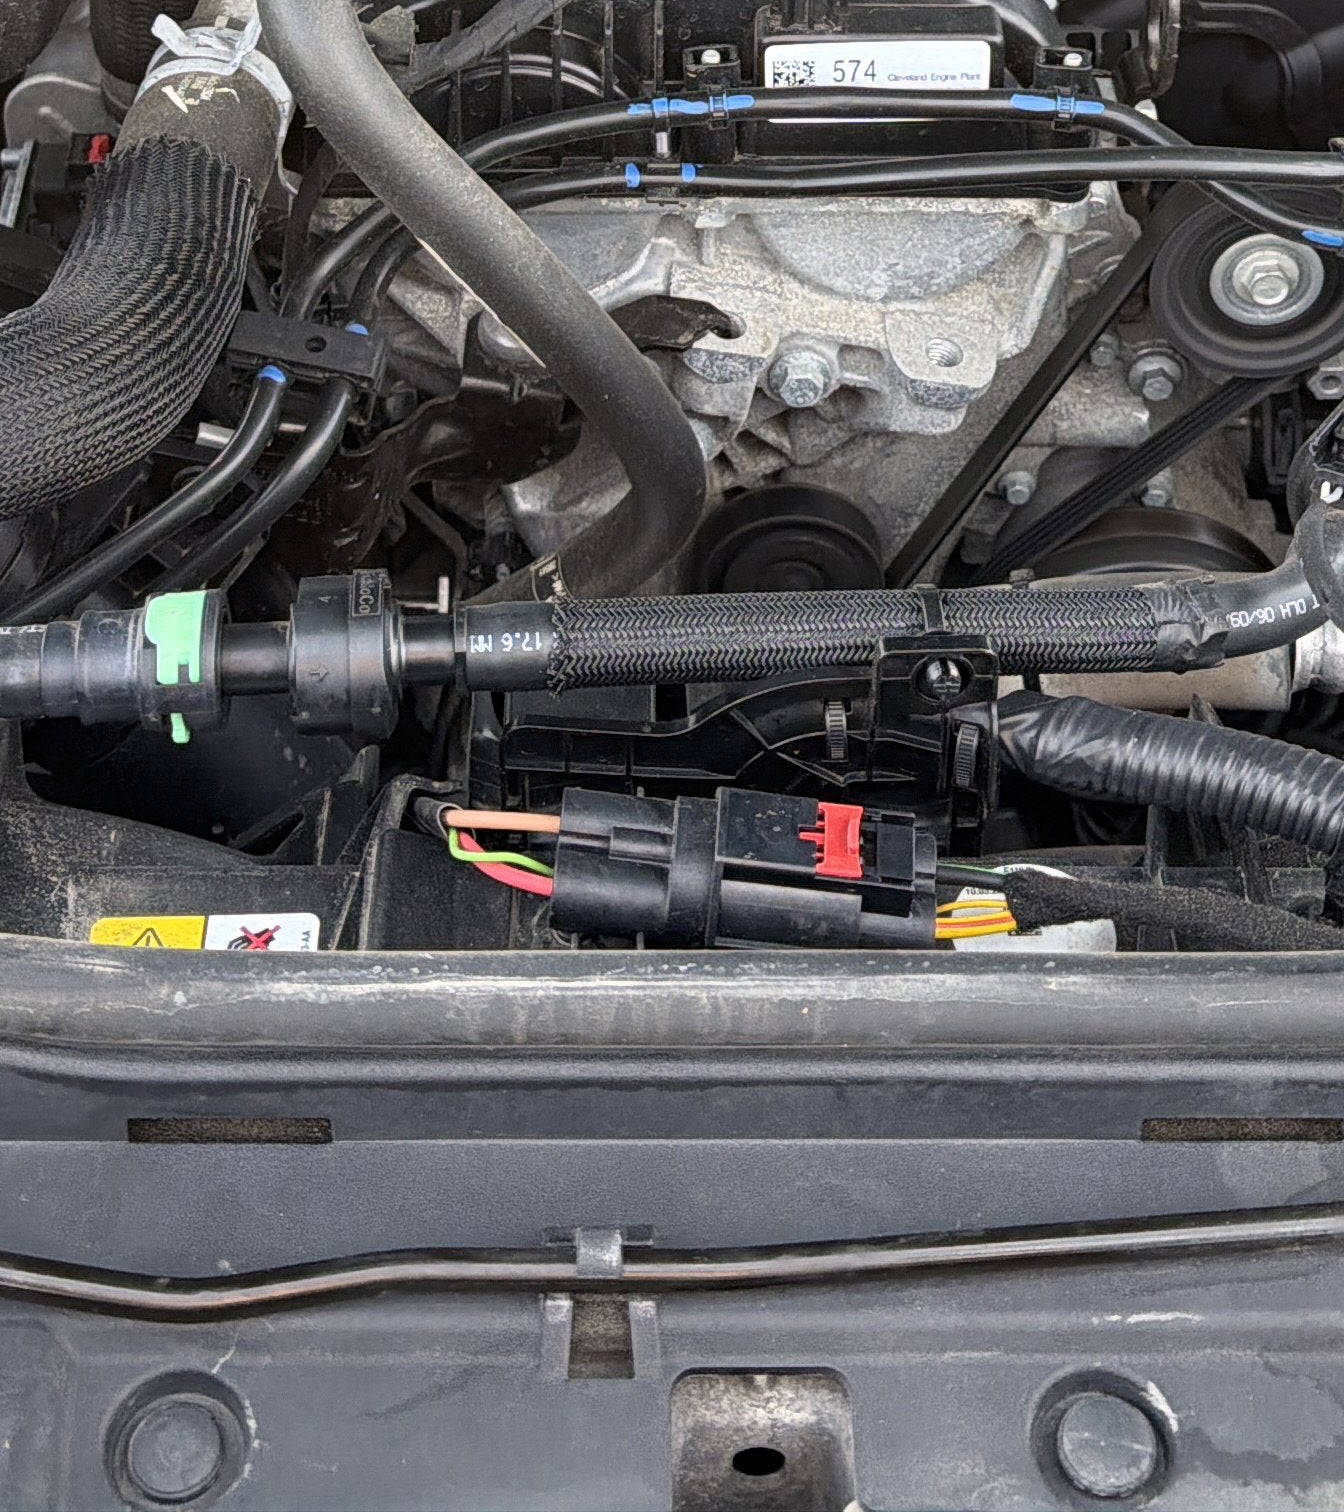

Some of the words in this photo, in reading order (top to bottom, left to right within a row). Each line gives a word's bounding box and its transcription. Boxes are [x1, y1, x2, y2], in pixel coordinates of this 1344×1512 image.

[832, 59, 877, 83] 574
[887, 73, 927, 82] Cleveland
[930, 73, 957, 82] Engine
[960, 72, 980, 81] Plant
[469, 634, 493, 653] MM
[501, 631, 542, 652] 17.6
